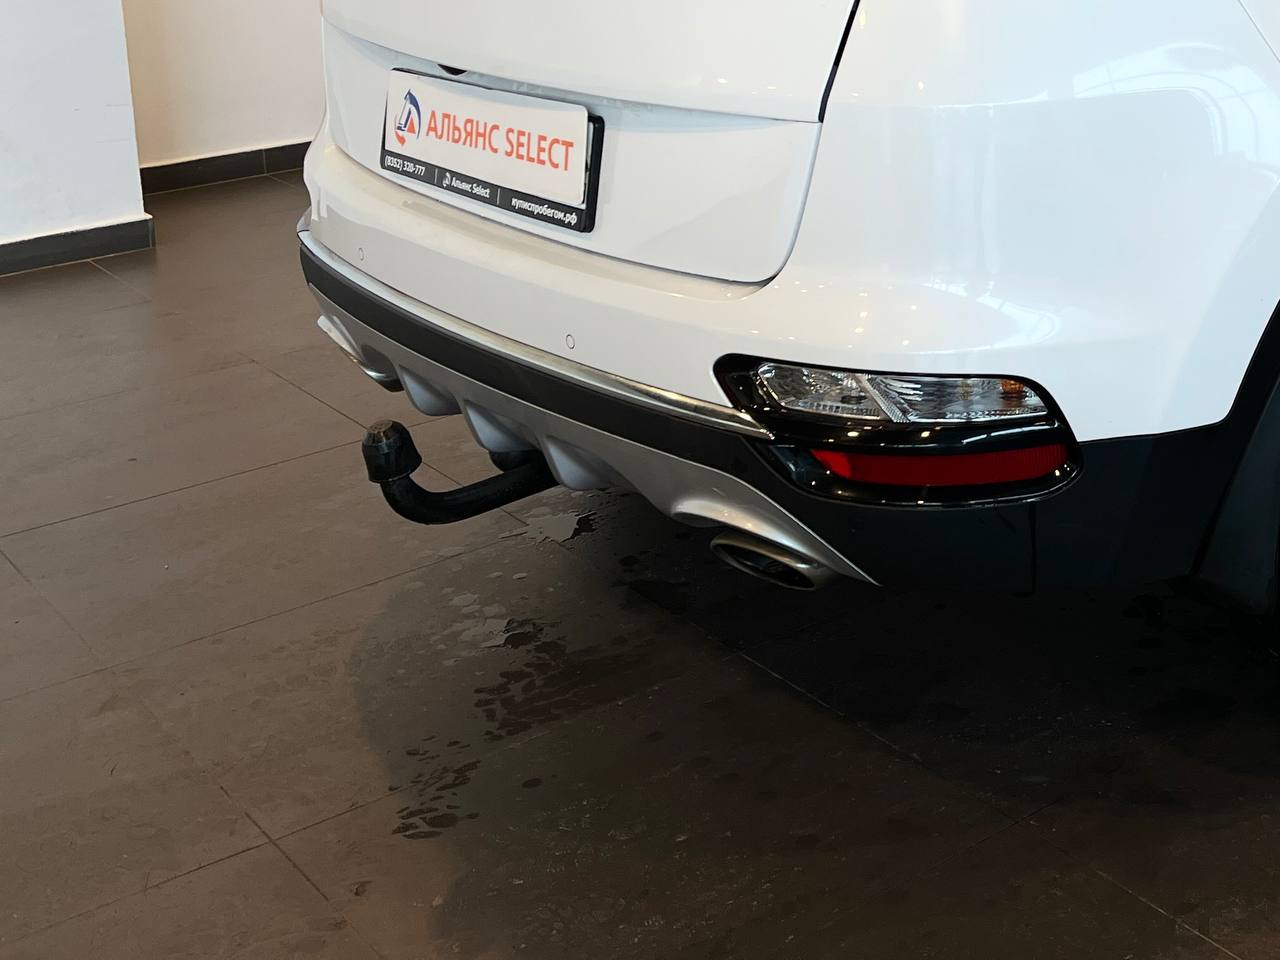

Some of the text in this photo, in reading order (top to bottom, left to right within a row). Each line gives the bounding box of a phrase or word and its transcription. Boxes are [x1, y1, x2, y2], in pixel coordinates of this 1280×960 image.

[426, 110, 574, 171] АЛЬЯНС SELECT
[385, 155, 425, 176] (8352) 320-777
[472, 183, 490, 198] Select
